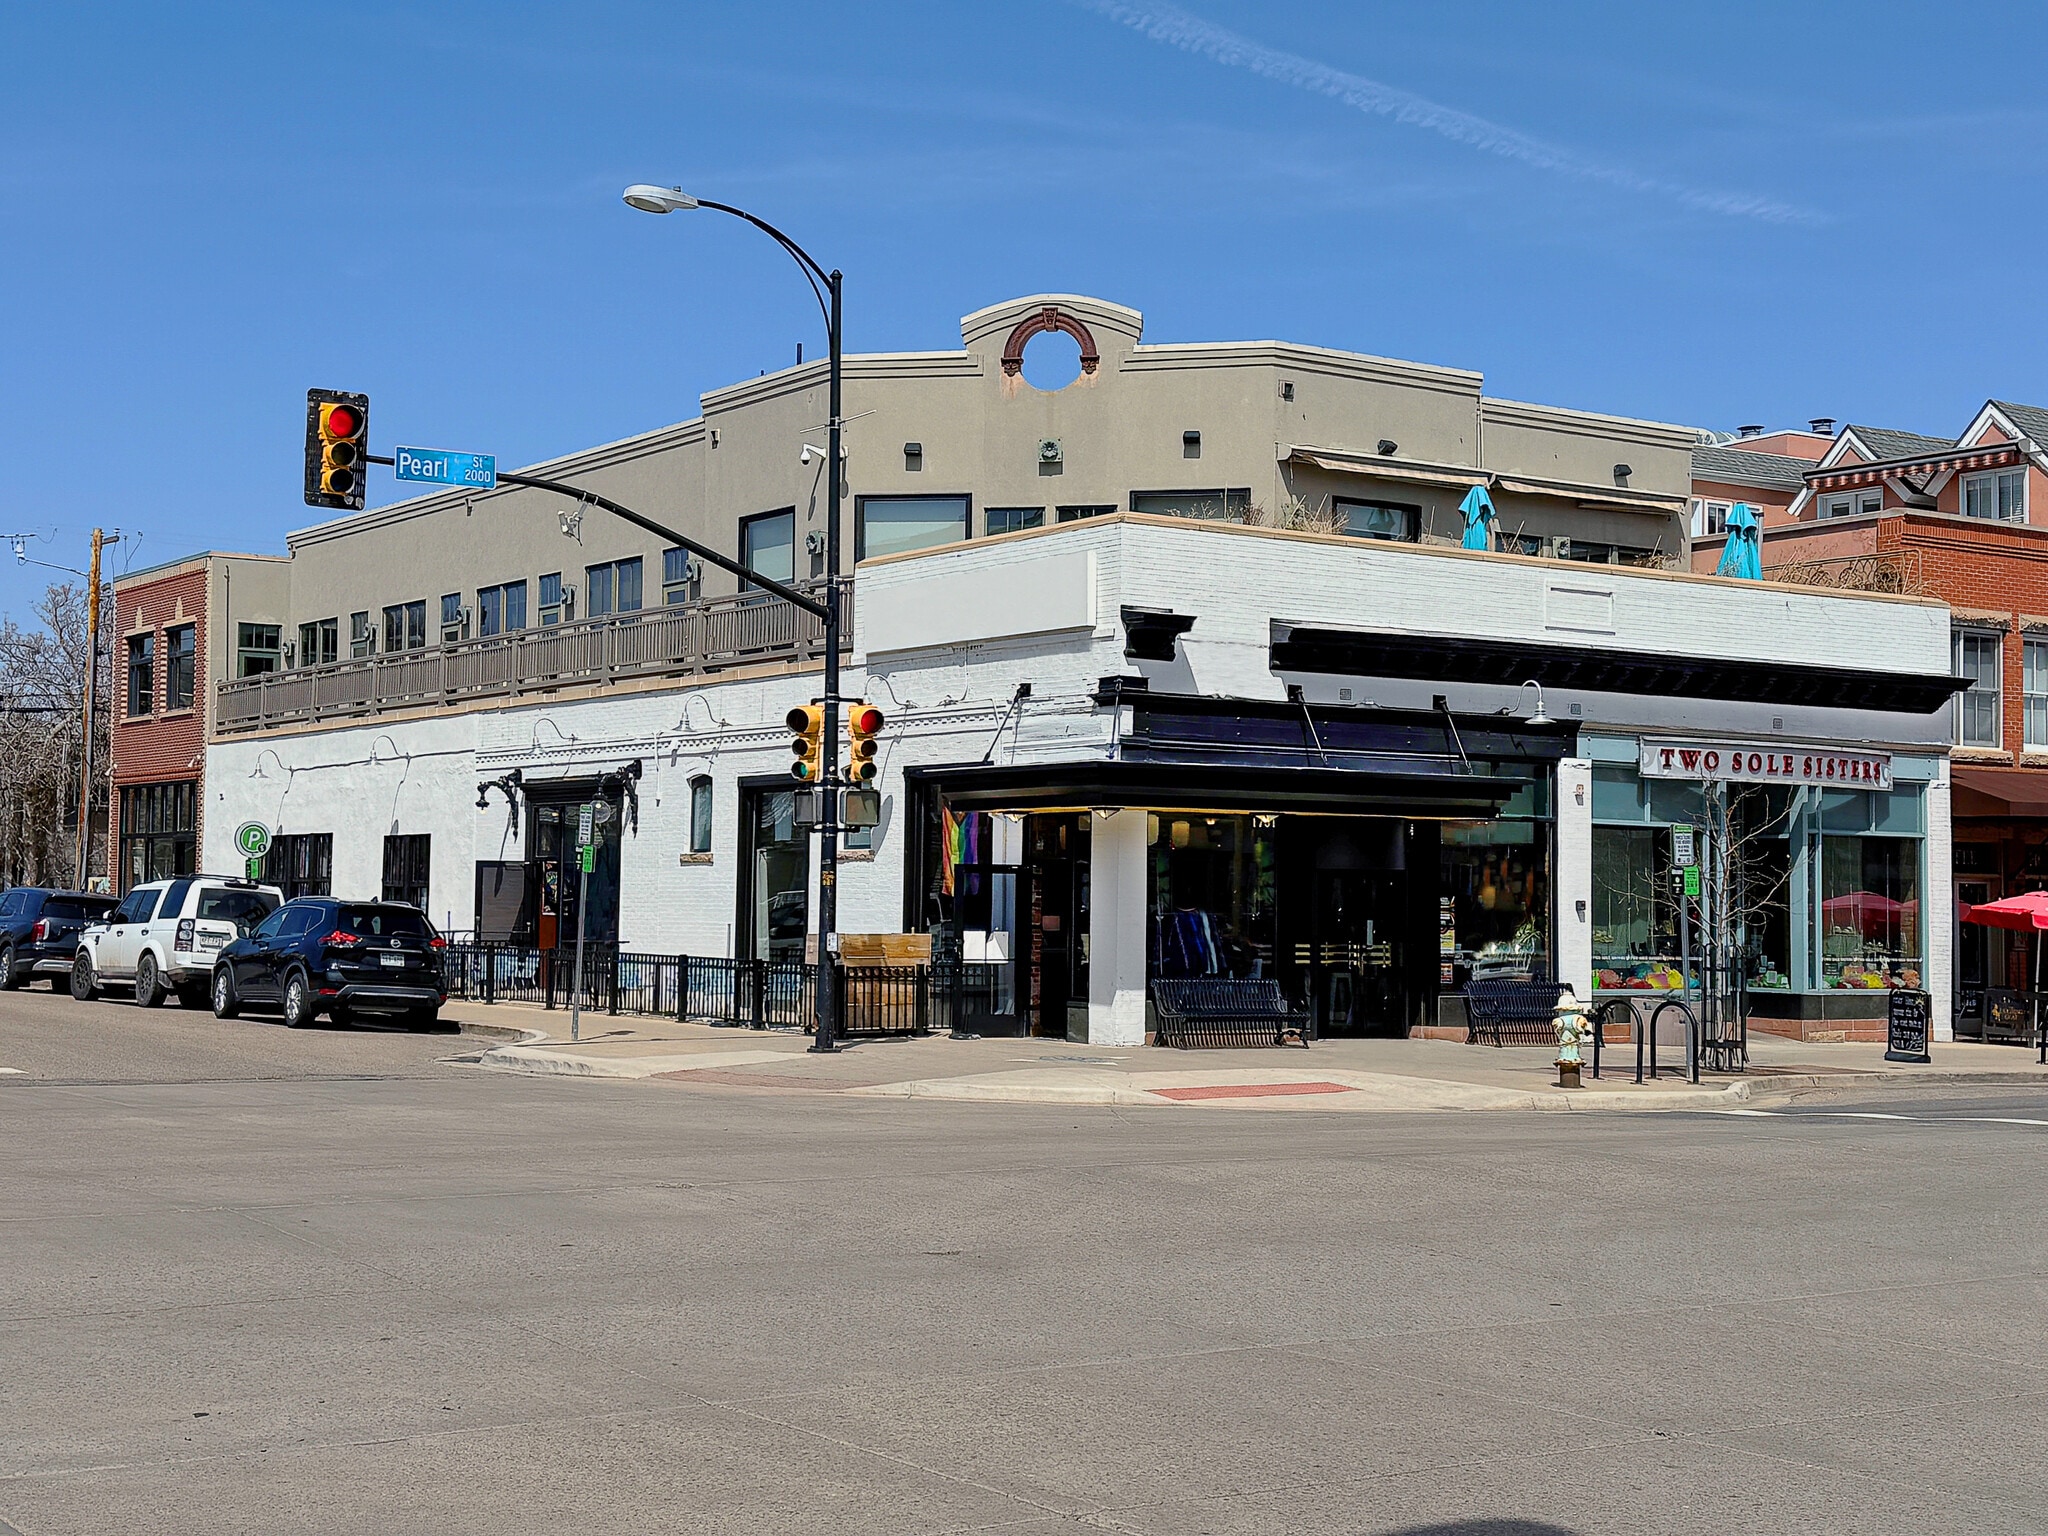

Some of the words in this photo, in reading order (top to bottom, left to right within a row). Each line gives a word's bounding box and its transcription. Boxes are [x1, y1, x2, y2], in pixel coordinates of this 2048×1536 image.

[399, 452, 448, 478] Pearl
[472, 456, 483, 469] St
[464, 469, 491, 483] 2000
[1659, 748, 1720, 772] TWO
[1731, 752, 1795, 774] SOLE
[1803, 756, 1882, 781] SISTERS
[247, 831, 261, 849] P
